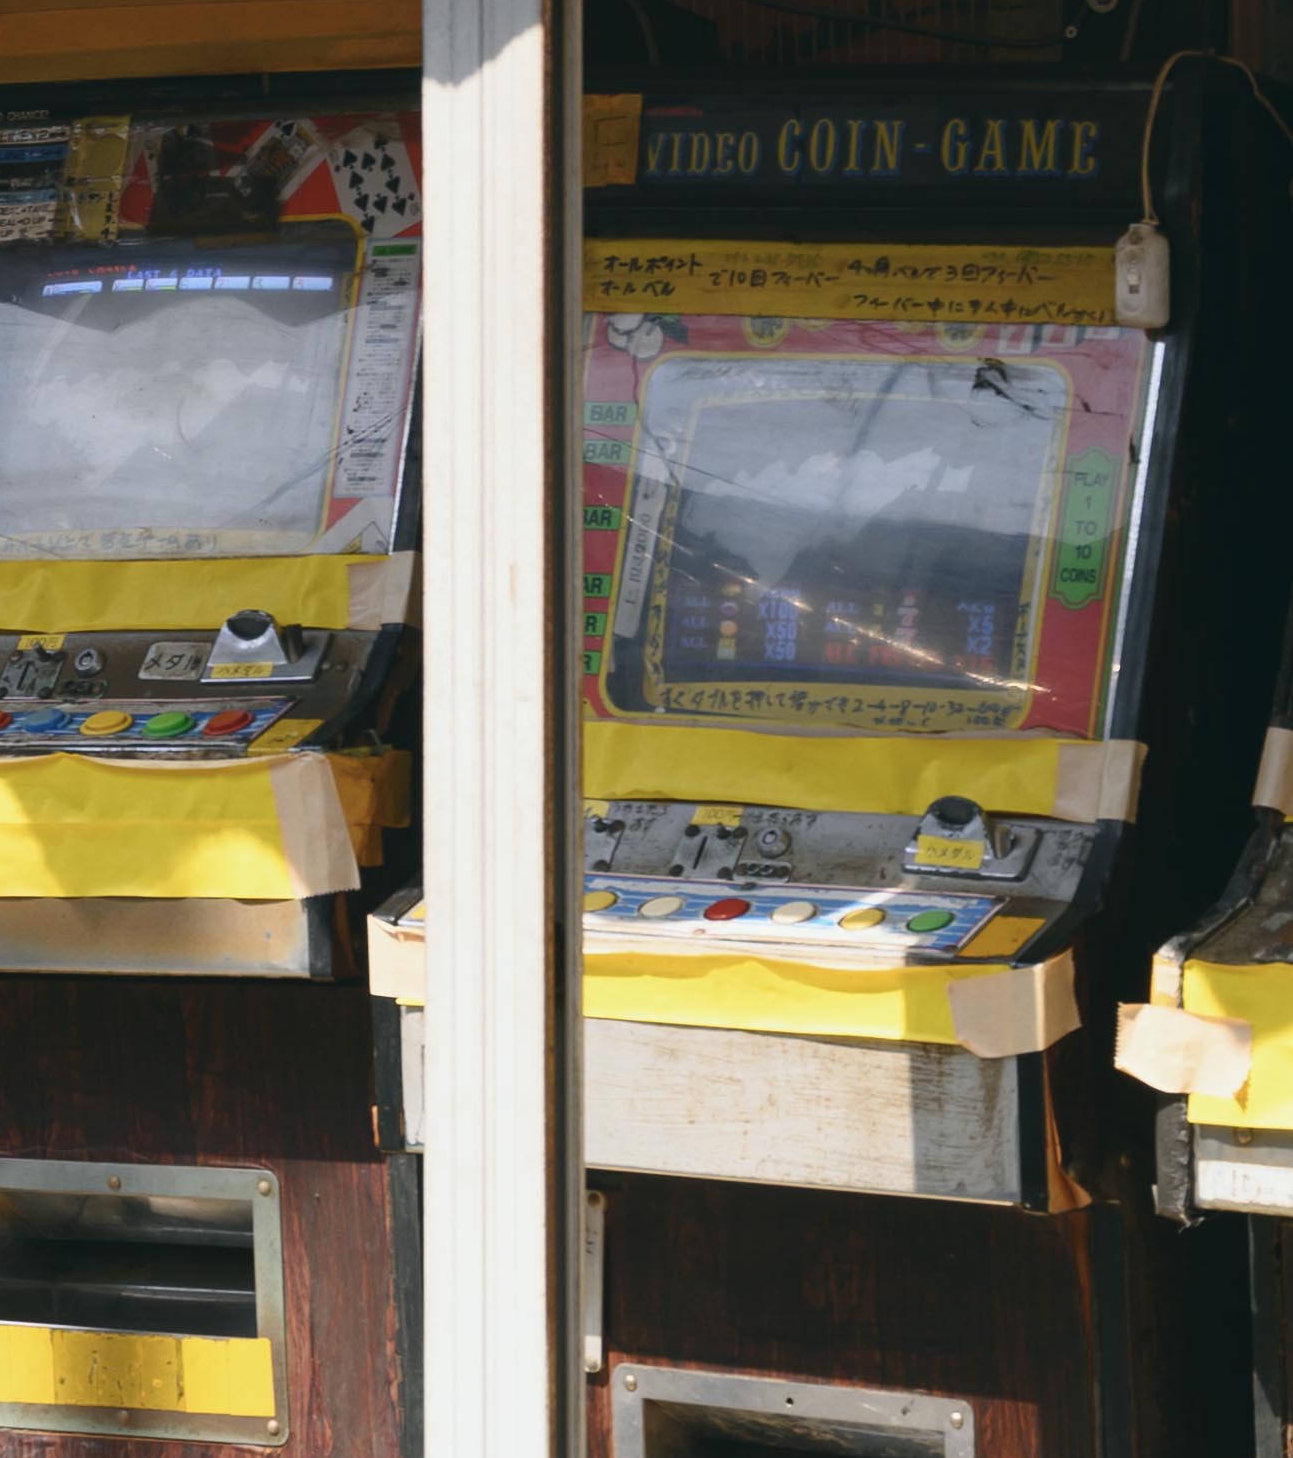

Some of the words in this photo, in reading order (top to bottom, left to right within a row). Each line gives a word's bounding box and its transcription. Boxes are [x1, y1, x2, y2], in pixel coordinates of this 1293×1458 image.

[646, 131, 760, 174] VIDEO
[589, 405, 628, 422] BAR
[583, 443, 623, 461] BAR
[1075, 471, 1110, 487] PLAY
[1086, 495, 1092, 510] 1
[1075, 520, 1097, 536] TO
[1075, 544, 1092, 559] 10
[1060, 568, 1096, 583] COINS
[766, 622, 797, 639] X50
[765, 642, 797, 660] X50
